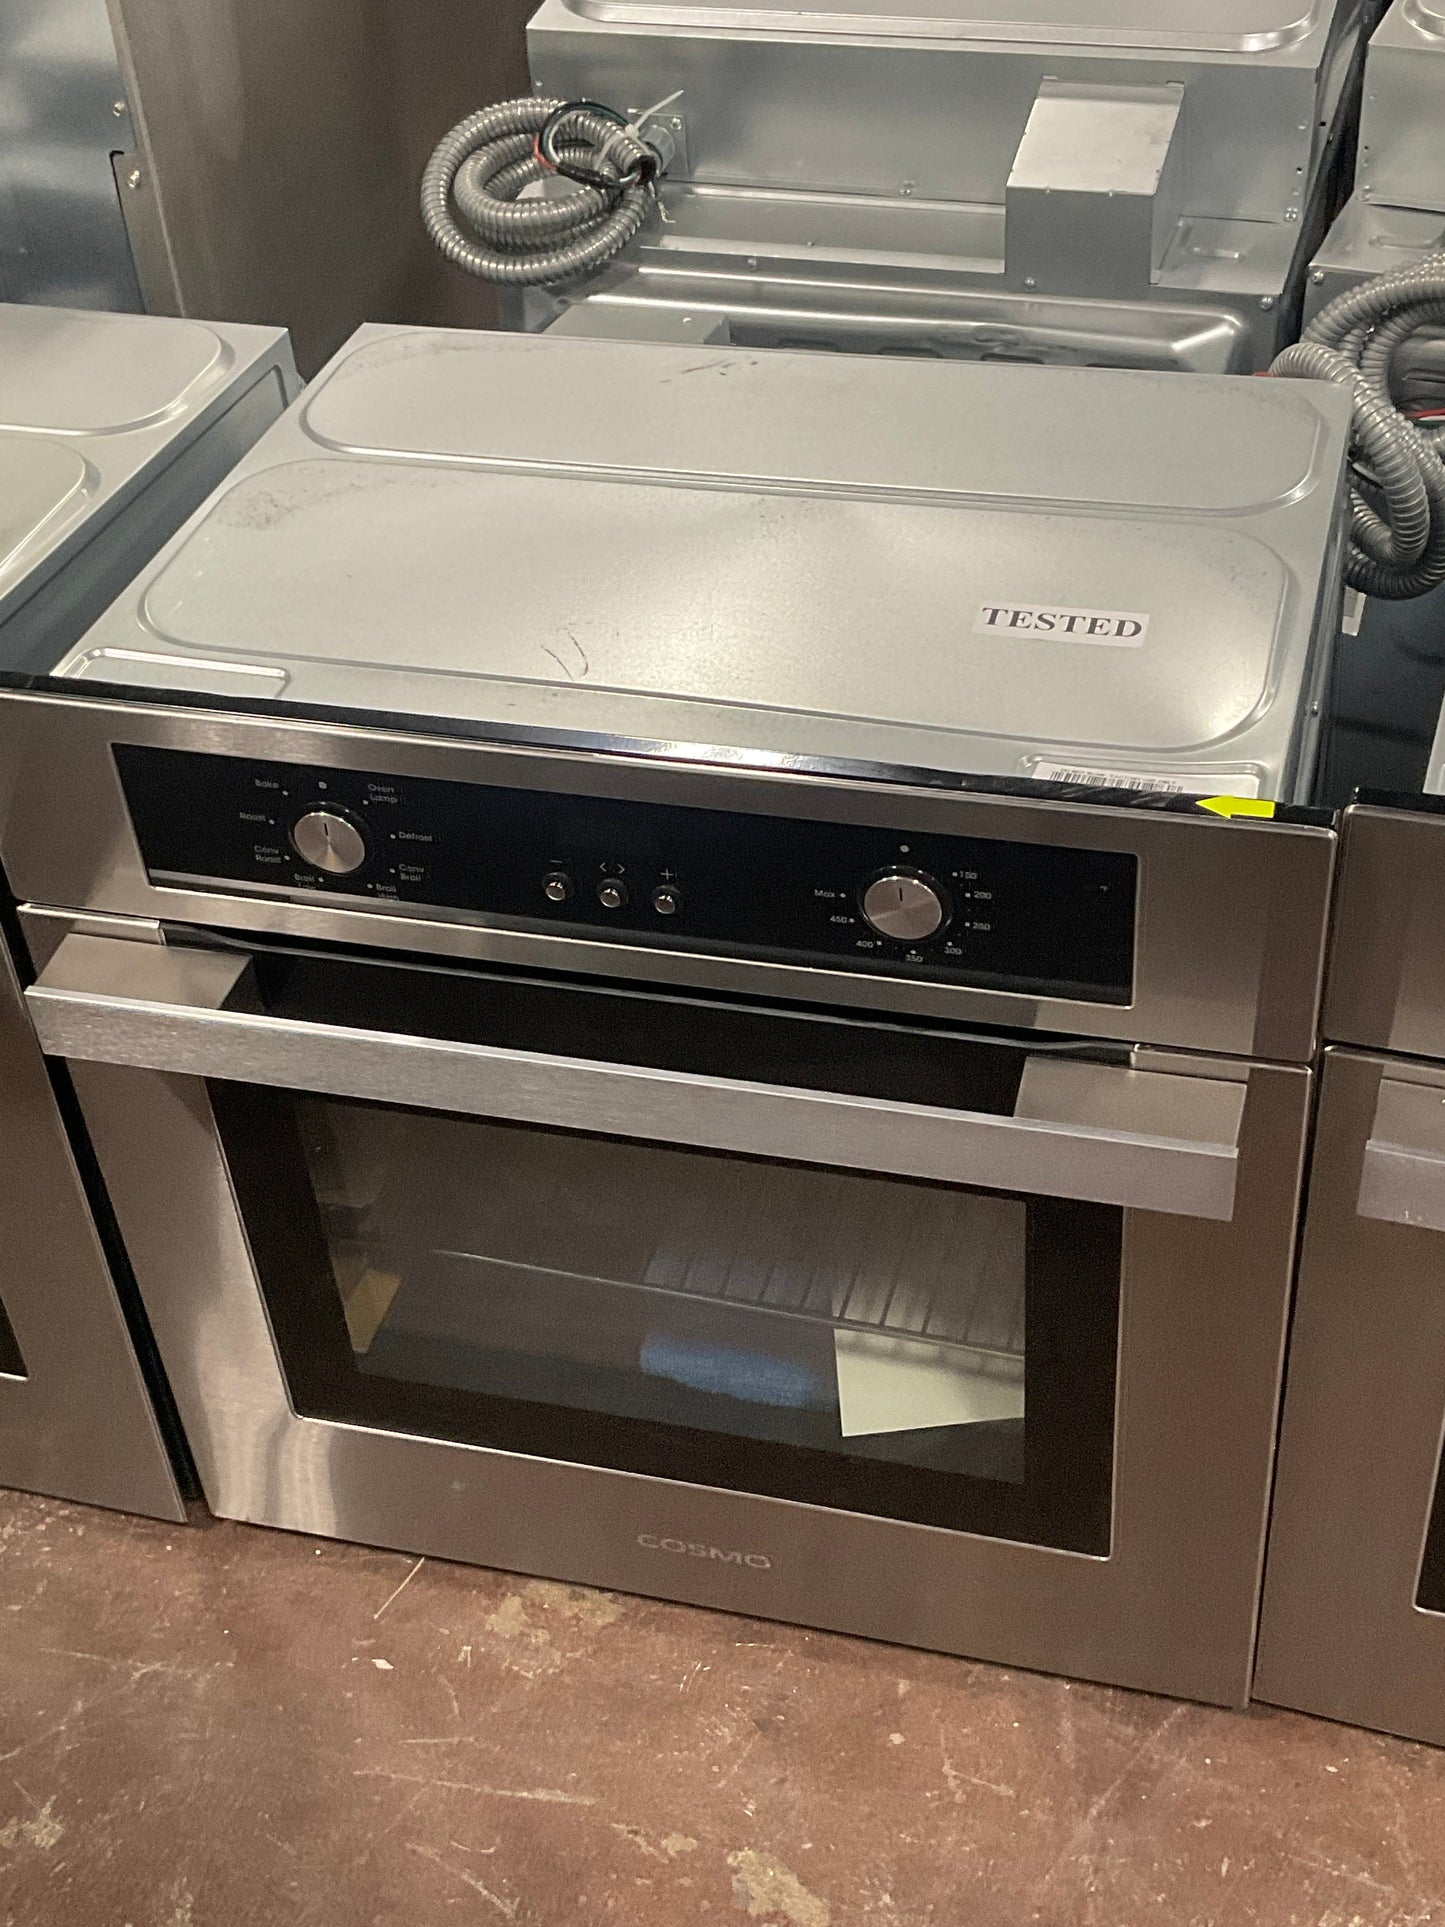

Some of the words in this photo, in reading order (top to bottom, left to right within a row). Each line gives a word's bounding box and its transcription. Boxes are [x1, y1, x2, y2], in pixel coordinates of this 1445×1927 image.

[982, 607, 1142, 637] TESTED
[255, 779, 279, 789] Bake
[368, 783, 395, 793] Oven
[370, 793, 397, 804] Lamp
[398, 831, 433, 842] Defrost
[959, 871, 977, 880] 150
[814, 889, 836, 898] Max
[973, 891, 992, 900] 200
[829, 915, 848, 923] 450
[855, 941, 874, 949] 400
[637, 1534, 772, 1568] COSMO
